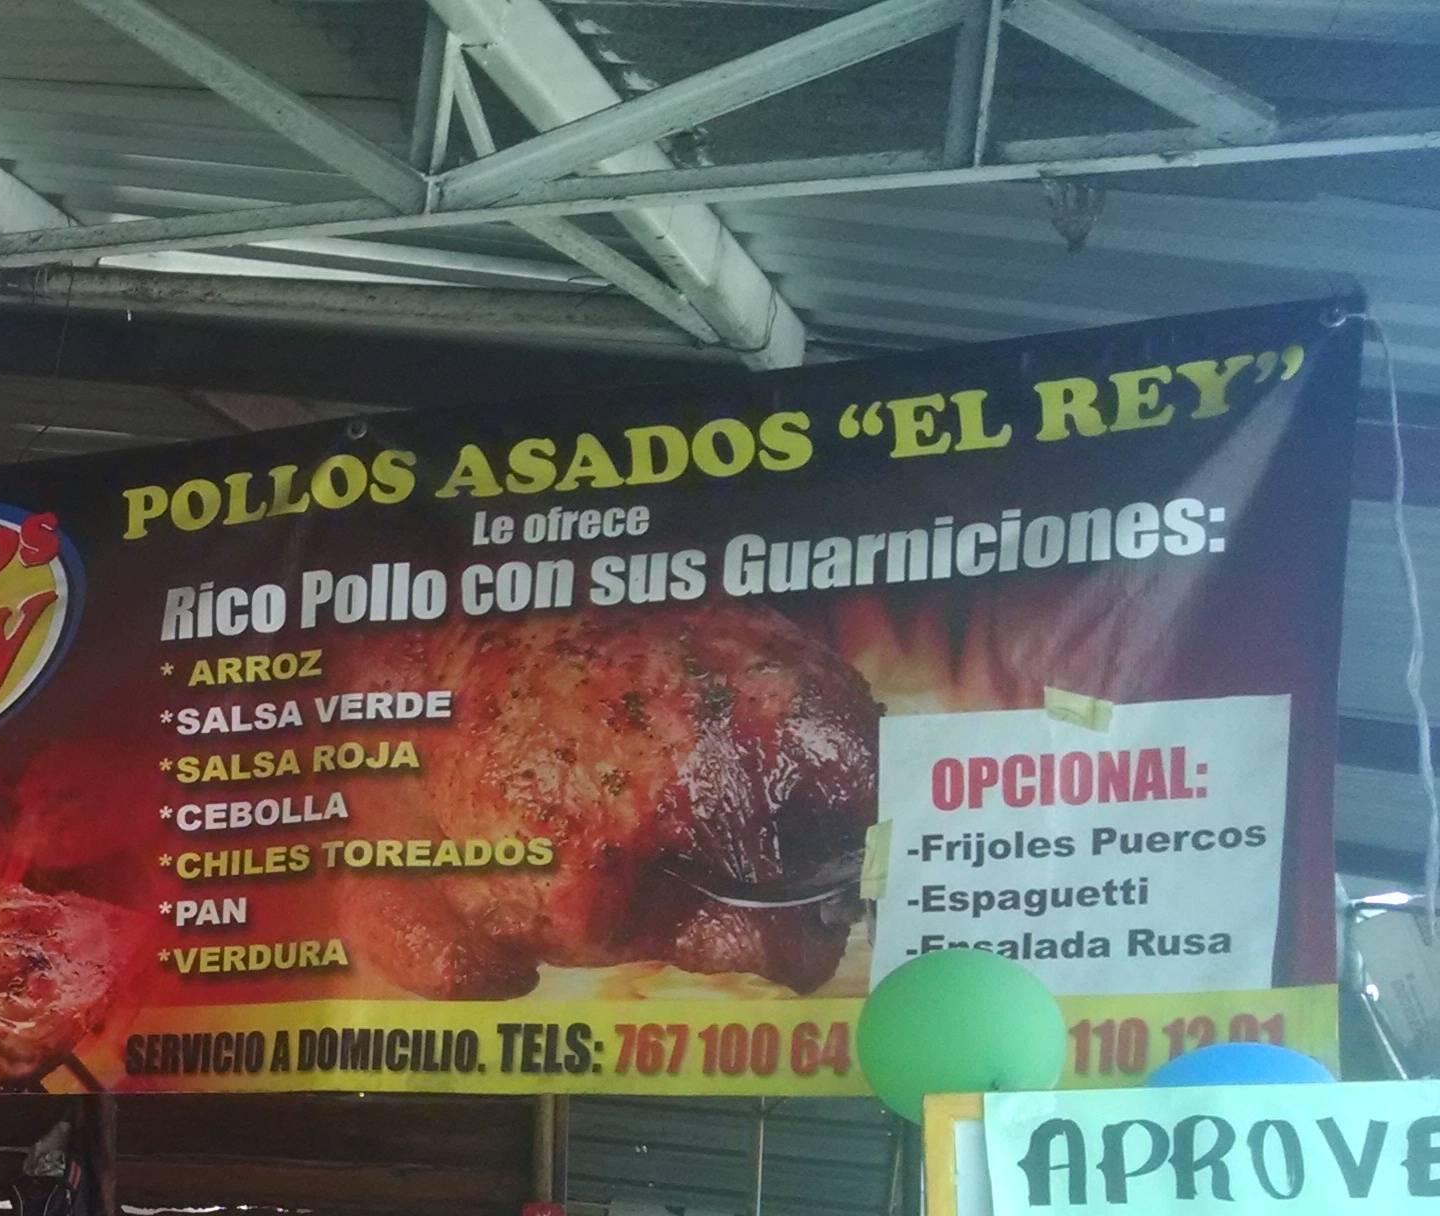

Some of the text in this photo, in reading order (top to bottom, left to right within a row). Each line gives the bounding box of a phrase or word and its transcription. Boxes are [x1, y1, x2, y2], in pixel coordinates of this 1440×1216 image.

[122, 344, 1305, 540] POLLOS ASADOS “EL REY”
[472, 505, 650, 546] Le ofrece
[160, 495, 1226, 642] Rico Pollo con sus Guarniciones:
[188, 650, 323, 687] ARROZ
[314, 691, 452, 723] VERDE
[313, 741, 420, 772] ROJA
[930, 745, 1208, 811] OPCIONAL:
[324, 837, 554, 868] TOREADOS
[906, 823, 1267, 868] -Frijoles Puercos
[906, 877, 1150, 918] -Espaguetti
[1127, 928, 1232, 957] Rusa
[124, 1031, 267, 1075] SERVICIO
[270, 1031, 291, 1073] A
[296, 1027, 485, 1074] DOMICILIO.
[496, 1022, 604, 1075] TELS:
[612, 1021, 689, 1075] 767
[698, 1021, 780, 1076] 100
[789, 1021, 852, 1076] 64
[1068, 1016, 1149, 1074] 110
